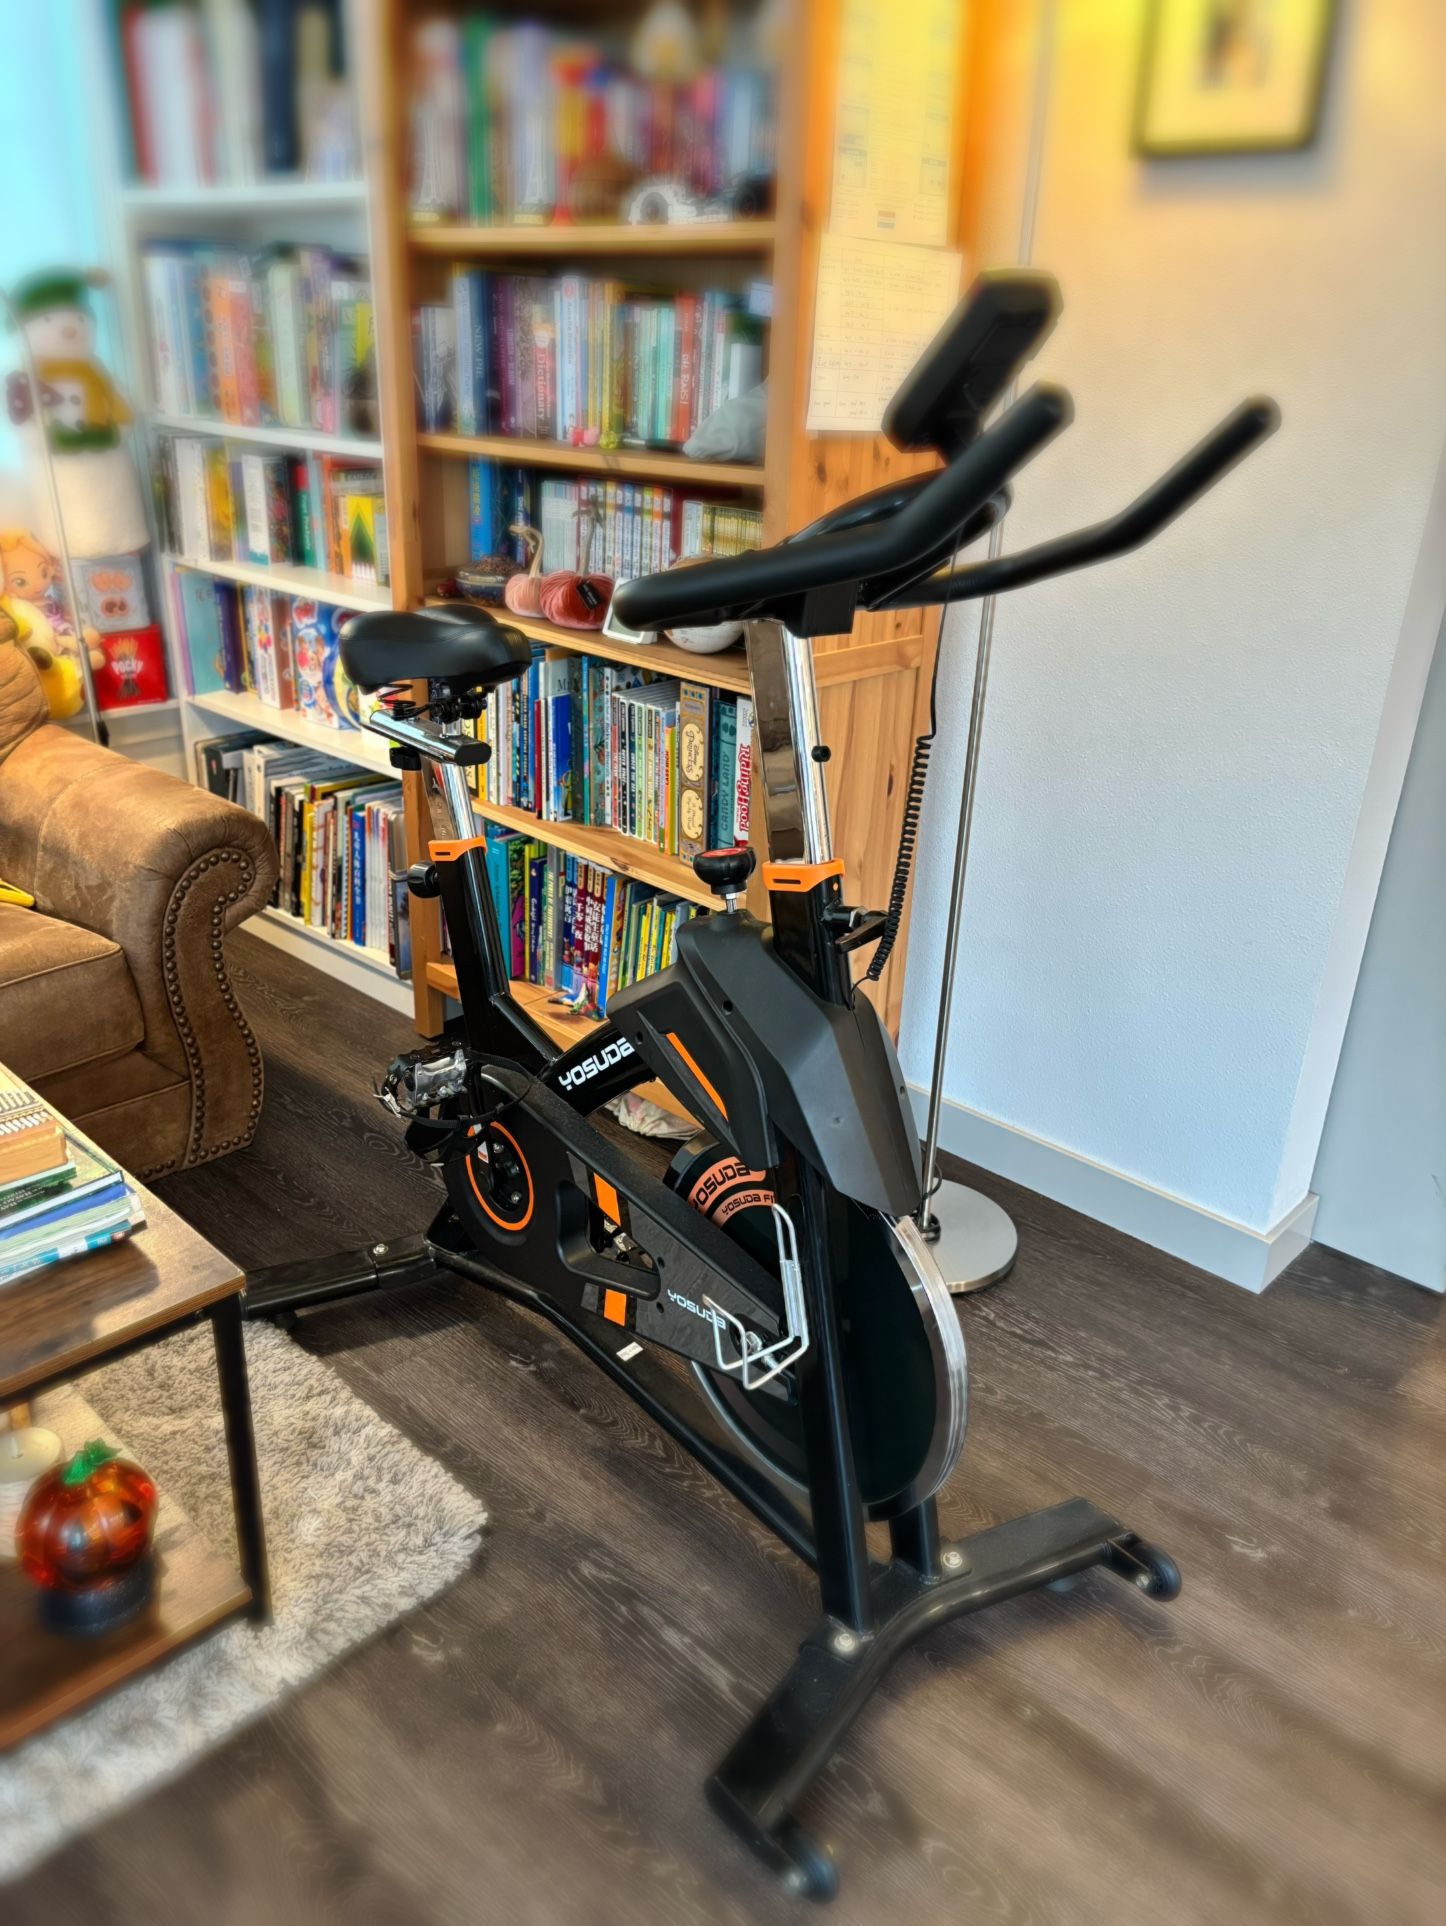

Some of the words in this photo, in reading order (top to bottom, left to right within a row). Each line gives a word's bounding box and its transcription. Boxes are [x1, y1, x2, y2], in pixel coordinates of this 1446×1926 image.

[535, 353, 546, 420] Dictionary
[111, 659, 144, 675] POCKY
[692, 744, 700, 766] Disney
[736, 793, 750, 833] Hood
[558, 1037, 635, 1091] YOSUDA
[722, 1193, 761, 1215] YOSUDA
[667, 1288, 727, 1330] YOSUDA
